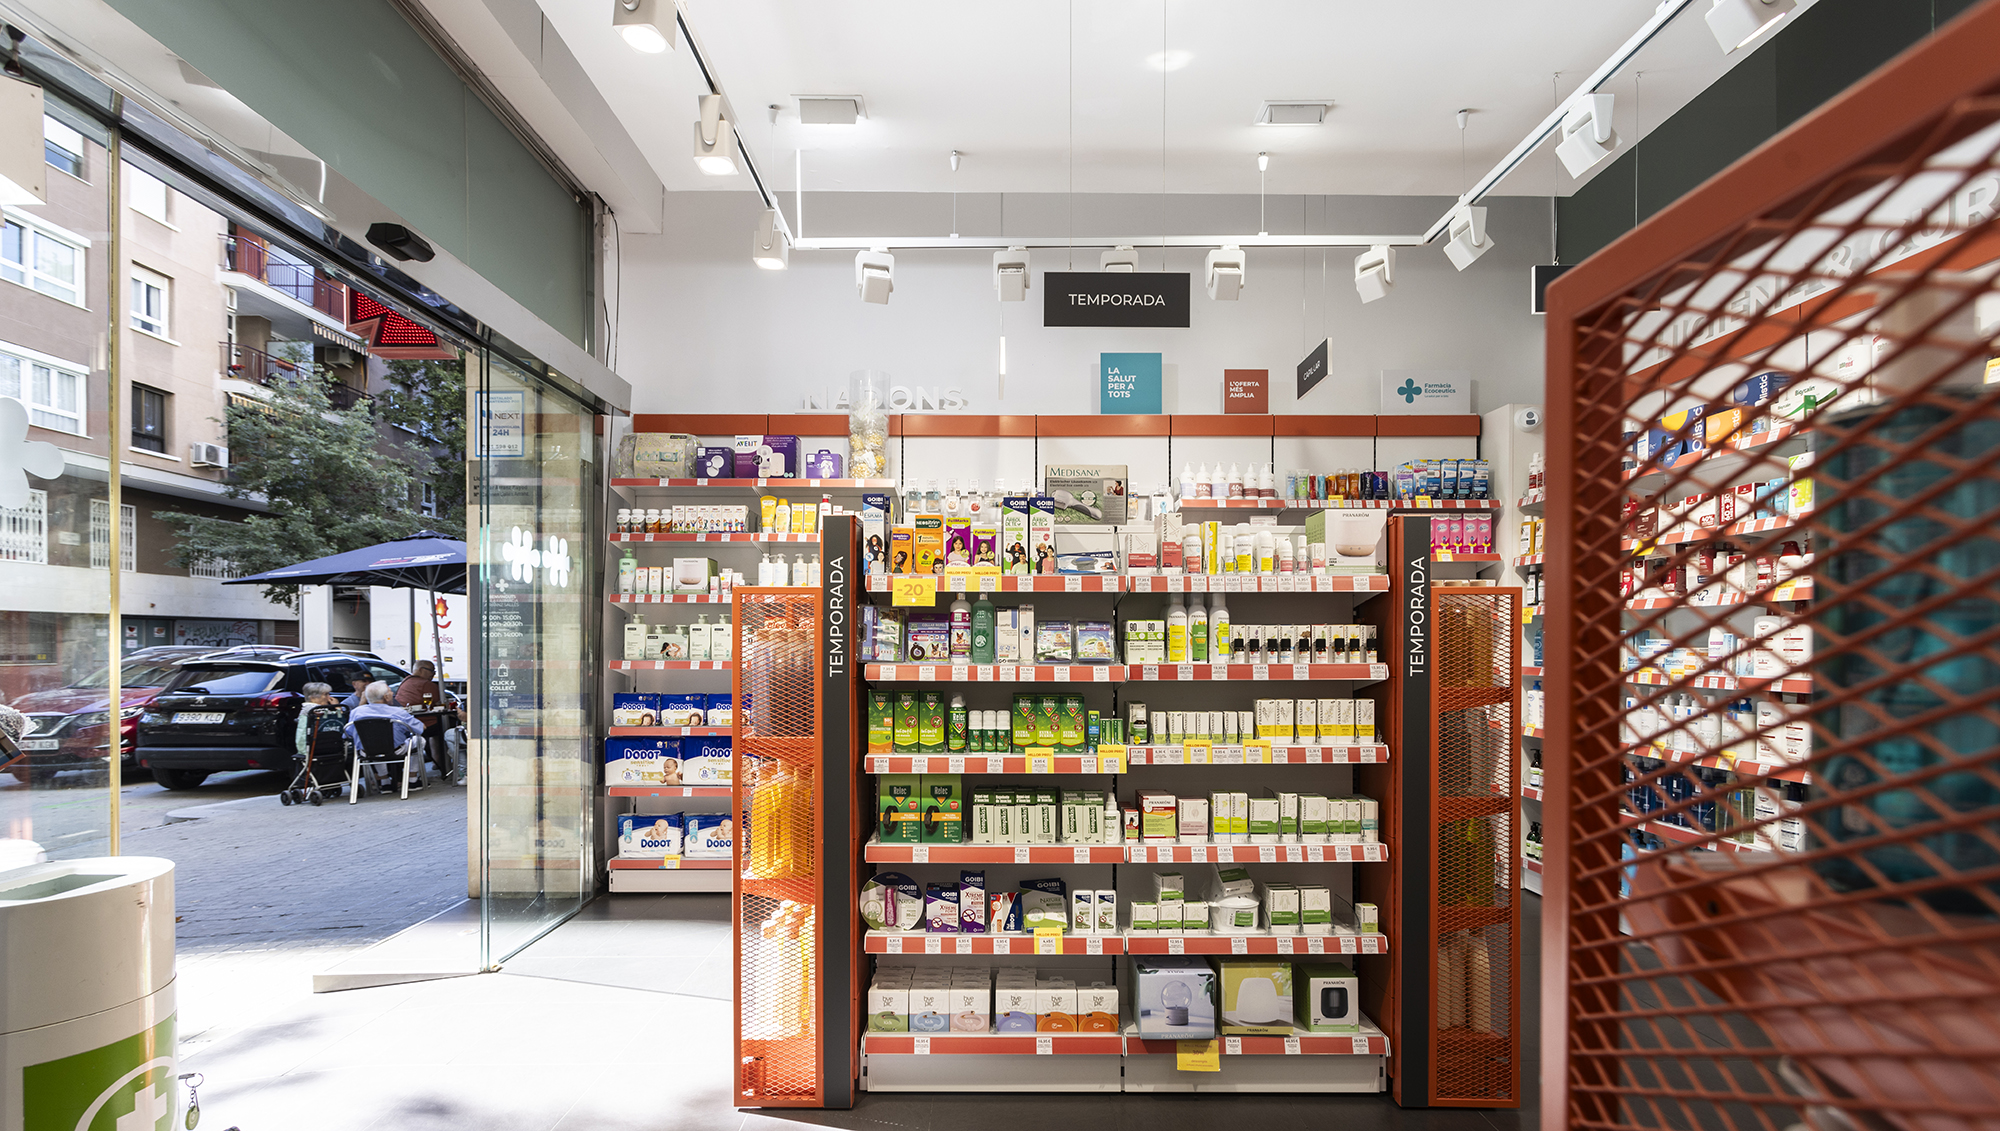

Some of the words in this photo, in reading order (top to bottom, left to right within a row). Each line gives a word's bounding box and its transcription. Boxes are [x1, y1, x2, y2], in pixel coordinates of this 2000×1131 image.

[1068, 293, 1166, 306] TEMPORADA
[896, 584, 924, 596] -20
[830, 556, 844, 678] TEMPORADA
[1410, 556, 1425, 677] TEMPORADA
[1130, 623, 1137, 632] 90
[1148, 623, 1155, 632] 90
[177, 713, 201, 722] 9390
[204, 713, 224, 722] KLD
[624, 748, 661, 760] DODOT
[641, 839, 671, 848] DODOT
[706, 839, 732, 848] DODO
